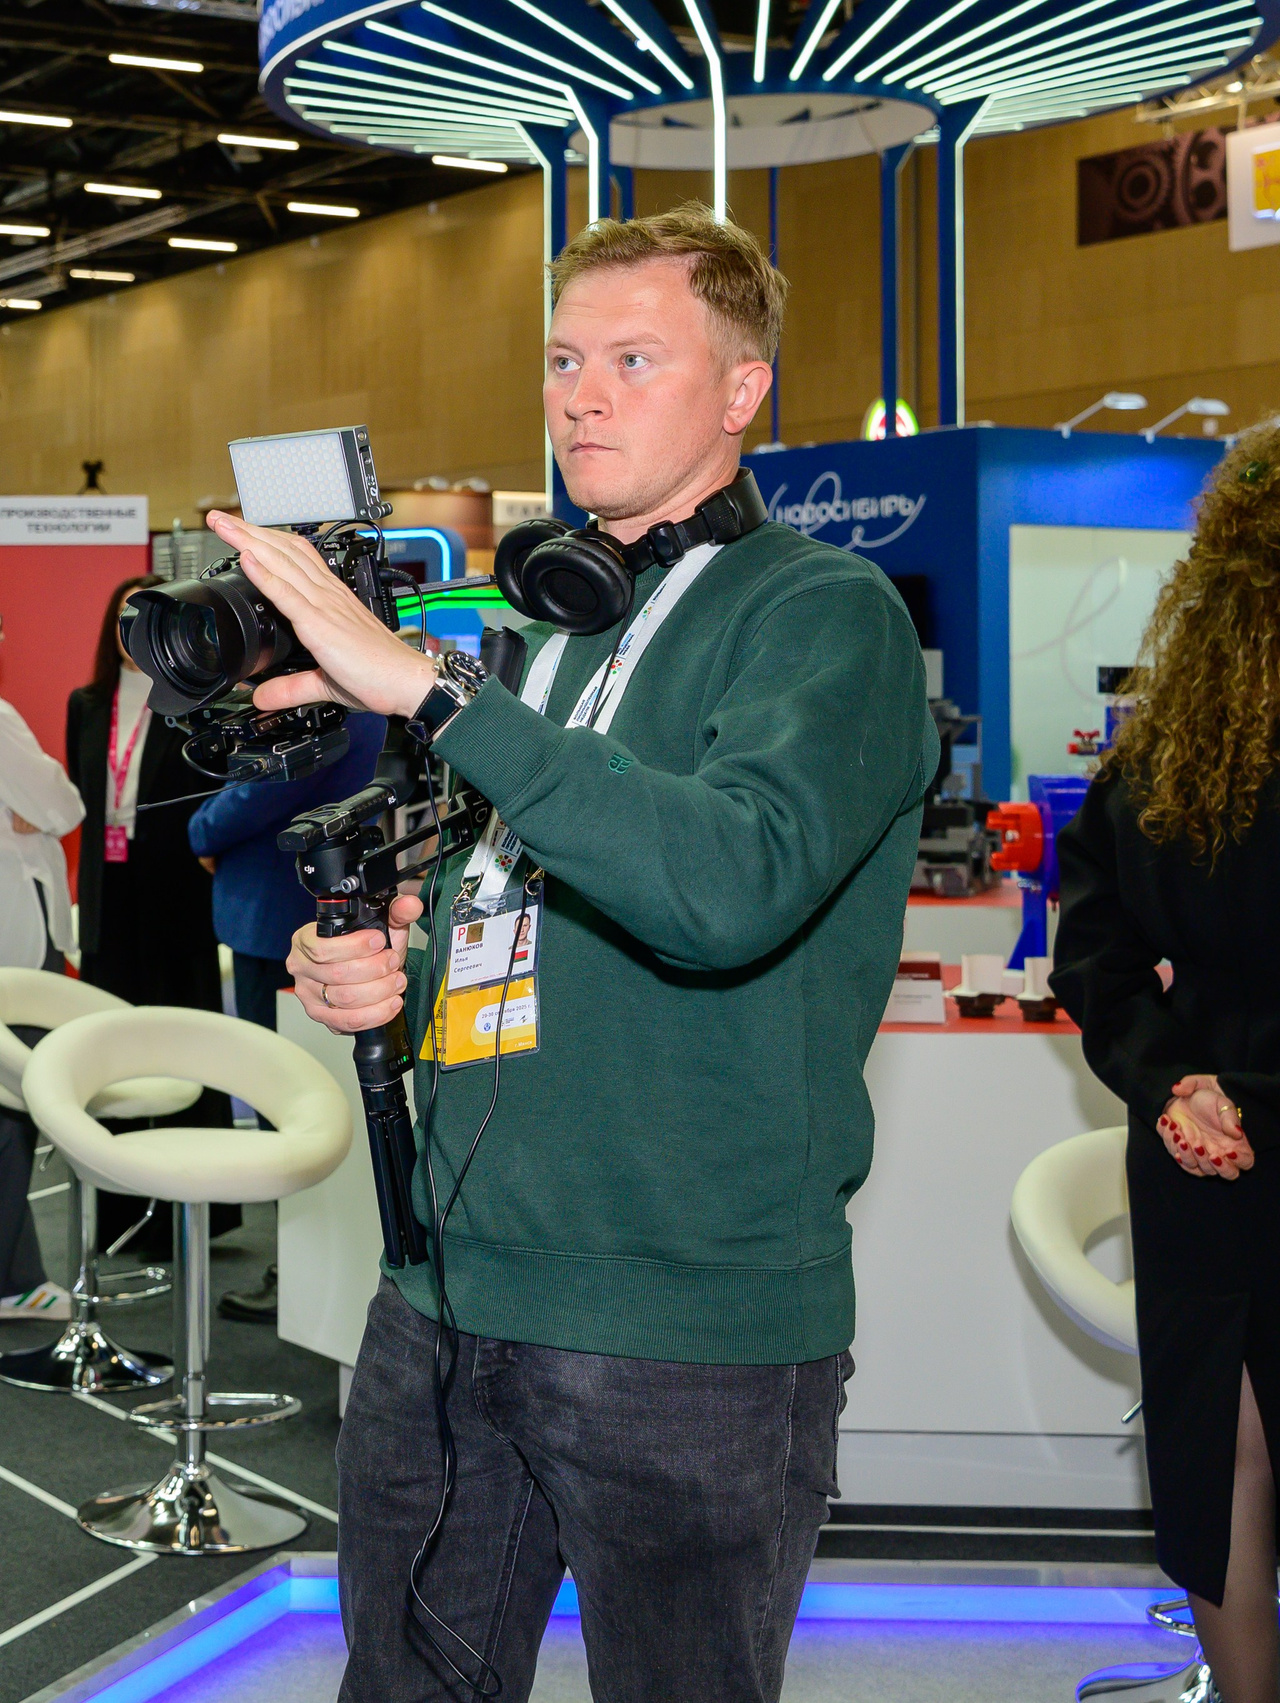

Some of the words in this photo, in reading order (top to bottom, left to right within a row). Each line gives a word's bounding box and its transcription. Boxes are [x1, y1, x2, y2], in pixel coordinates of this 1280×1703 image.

[0, 507, 137, 519] ПРОИЗВОДСТВЕННЫЕ
[27, 523, 112, 534] ТЕХНОЛОГИИ
[455, 942, 484, 954] ВАНЮКОВ
